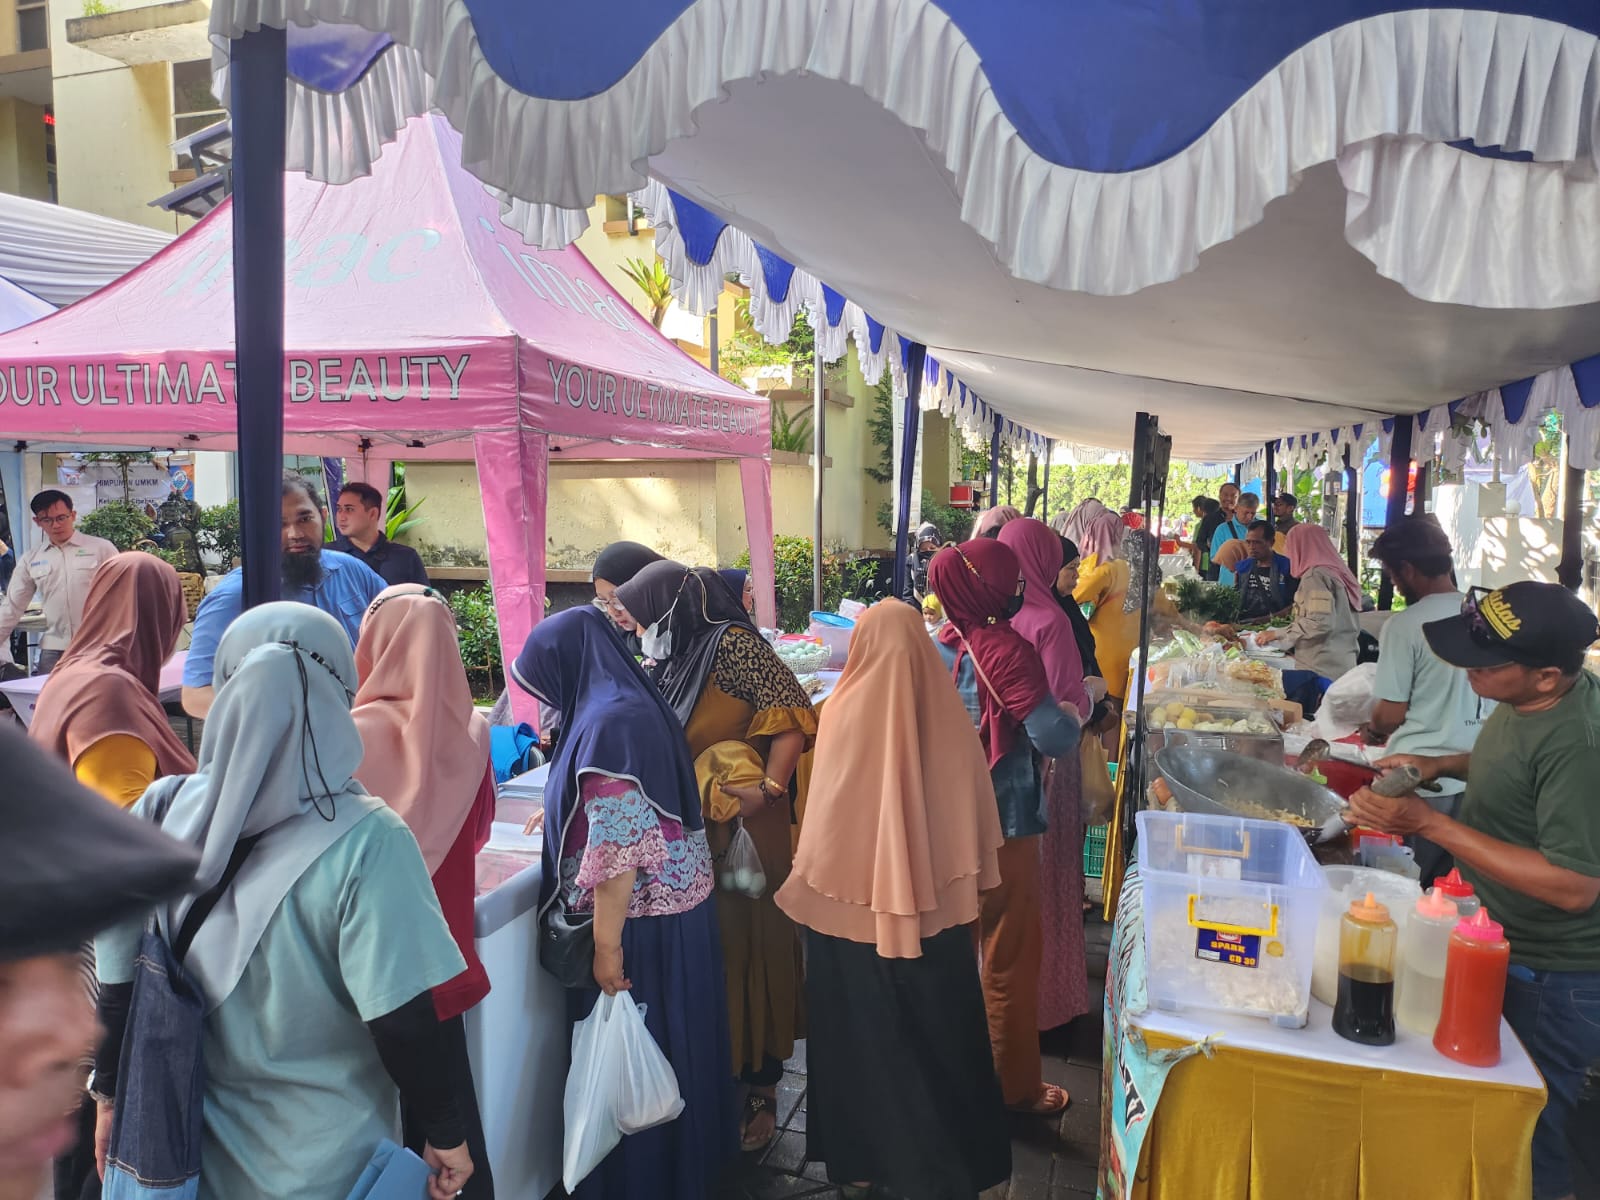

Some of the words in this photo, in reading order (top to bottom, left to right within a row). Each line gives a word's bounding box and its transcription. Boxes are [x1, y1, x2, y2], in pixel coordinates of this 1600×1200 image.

[289, 354, 470, 402] BEAUTY
[547, 359, 617, 415] YOUR
[622, 377, 709, 429] ULTIMATE
[711, 400, 761, 437] BEAUTY
